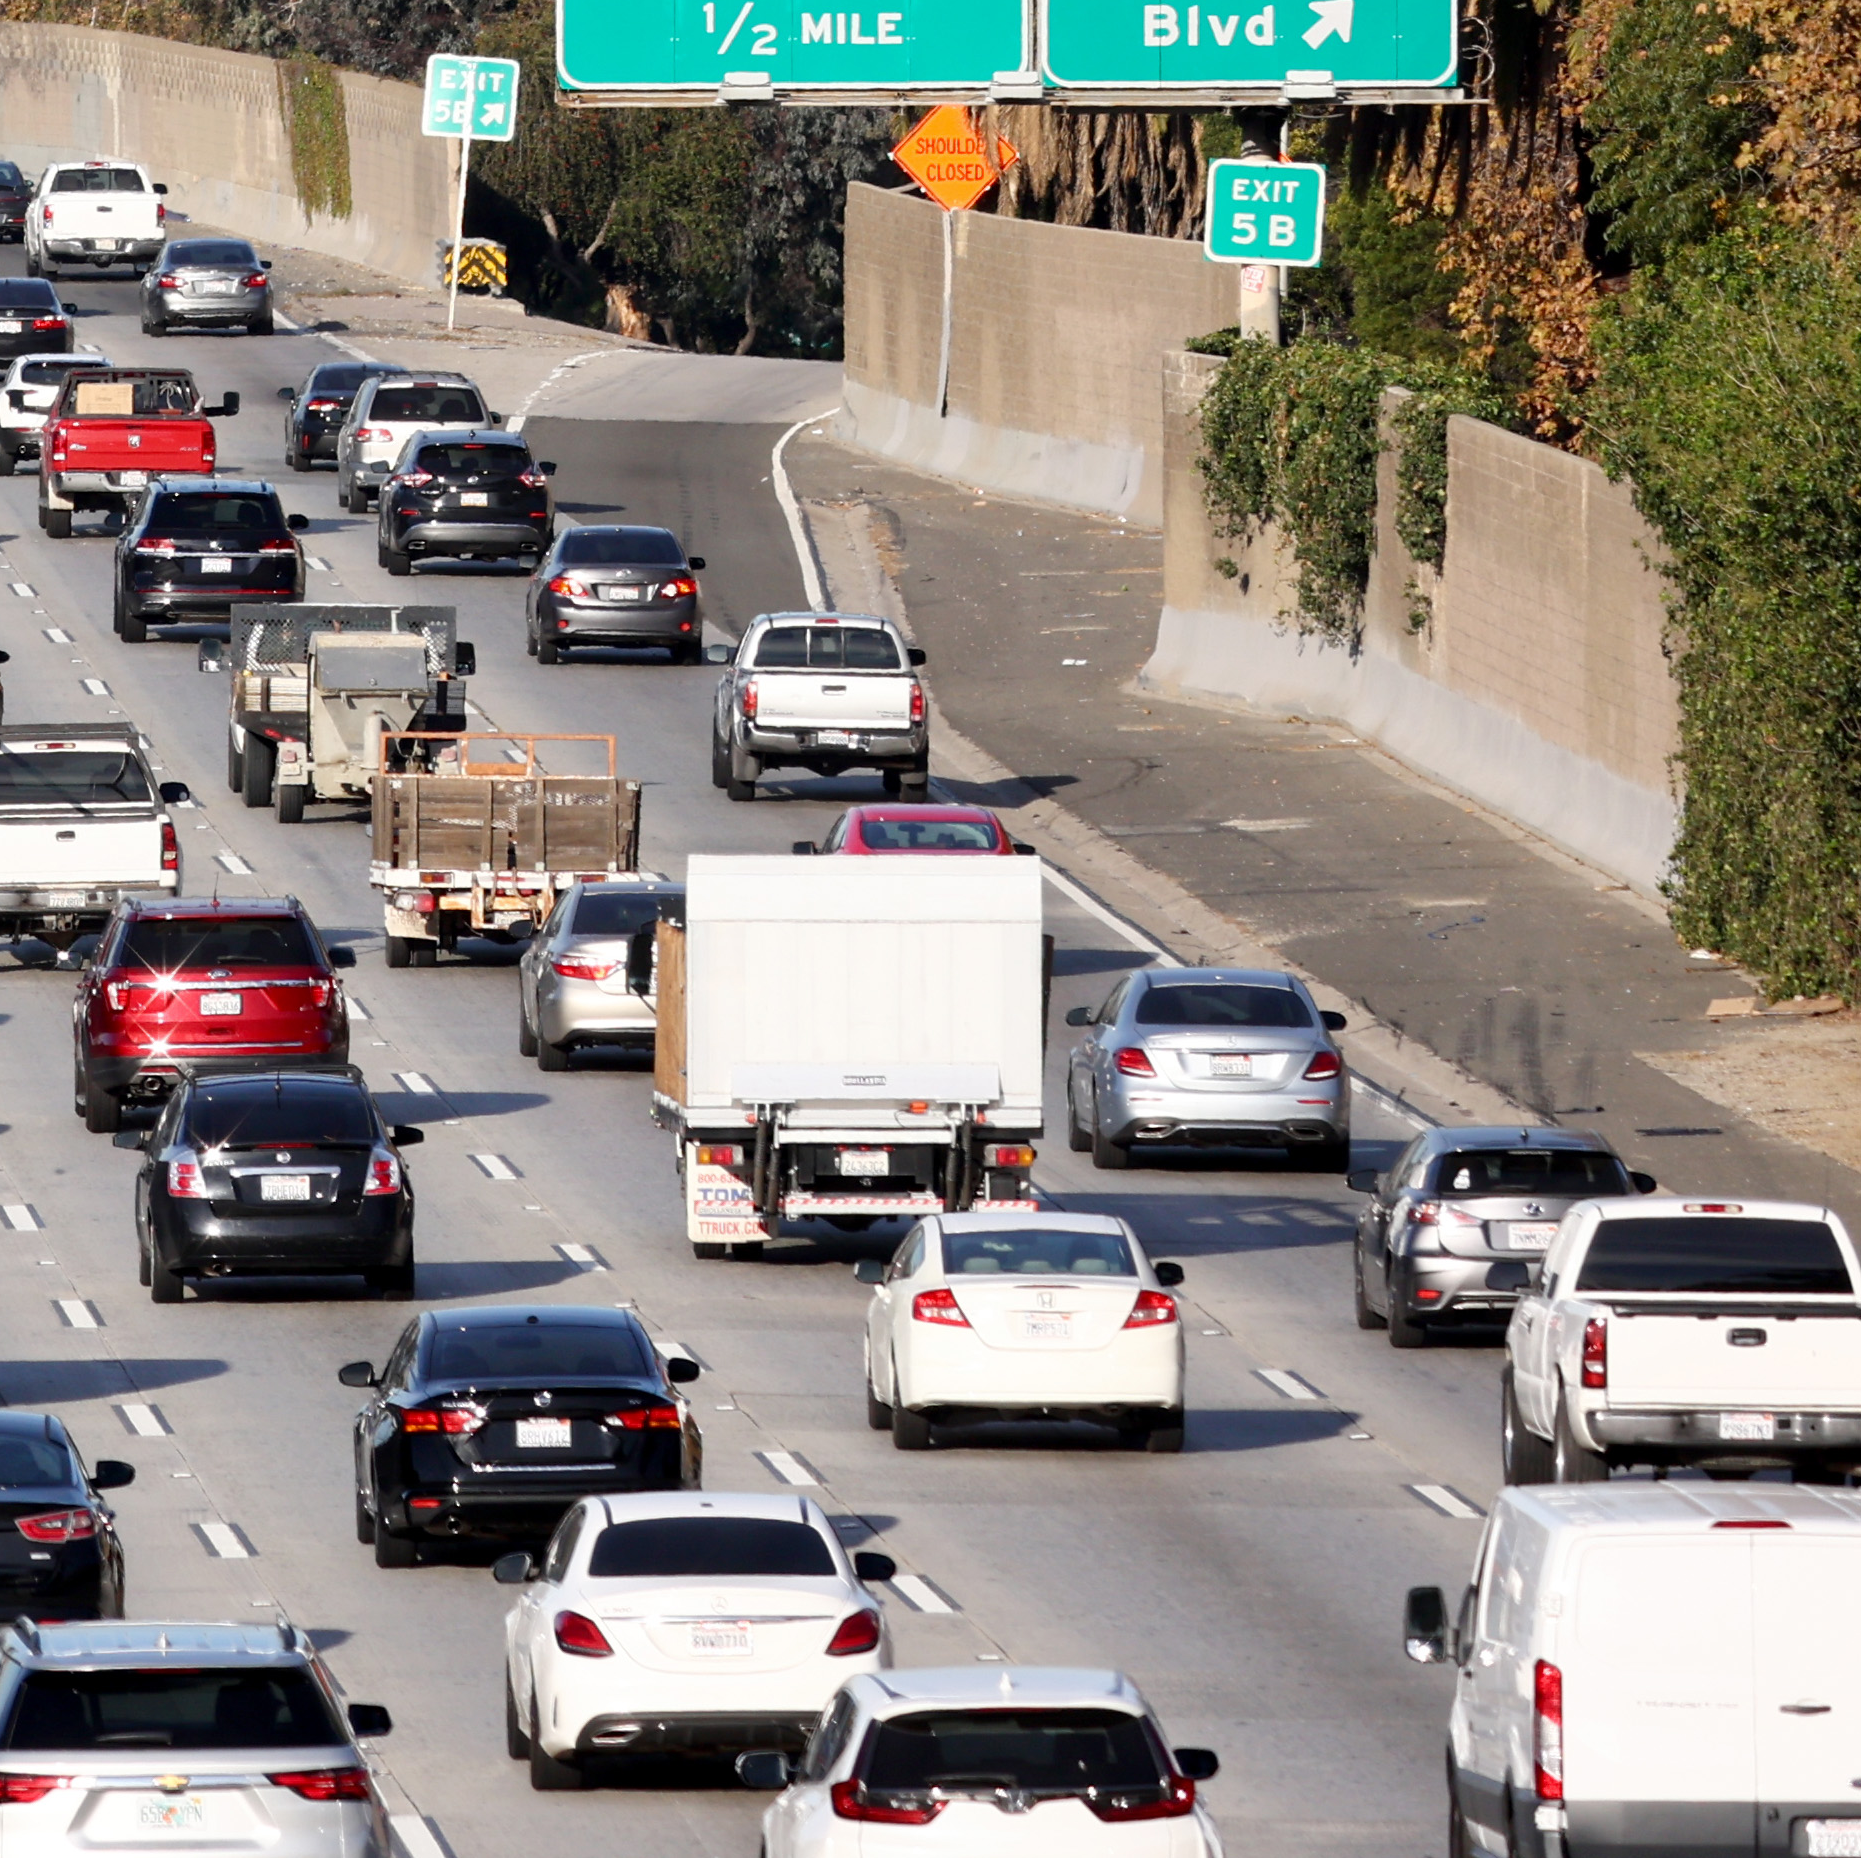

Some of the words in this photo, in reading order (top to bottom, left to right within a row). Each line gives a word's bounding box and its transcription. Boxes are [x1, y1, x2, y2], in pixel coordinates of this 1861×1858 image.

[800, 12, 904, 45] MILE
[1143, 4, 1275, 47] Blvd
[439, 68, 505, 93] EXIT
[915, 137, 985, 155] SHOULDE
[926, 163, 985, 182] CLOSED
[1231, 178, 1301, 203] EXIT
